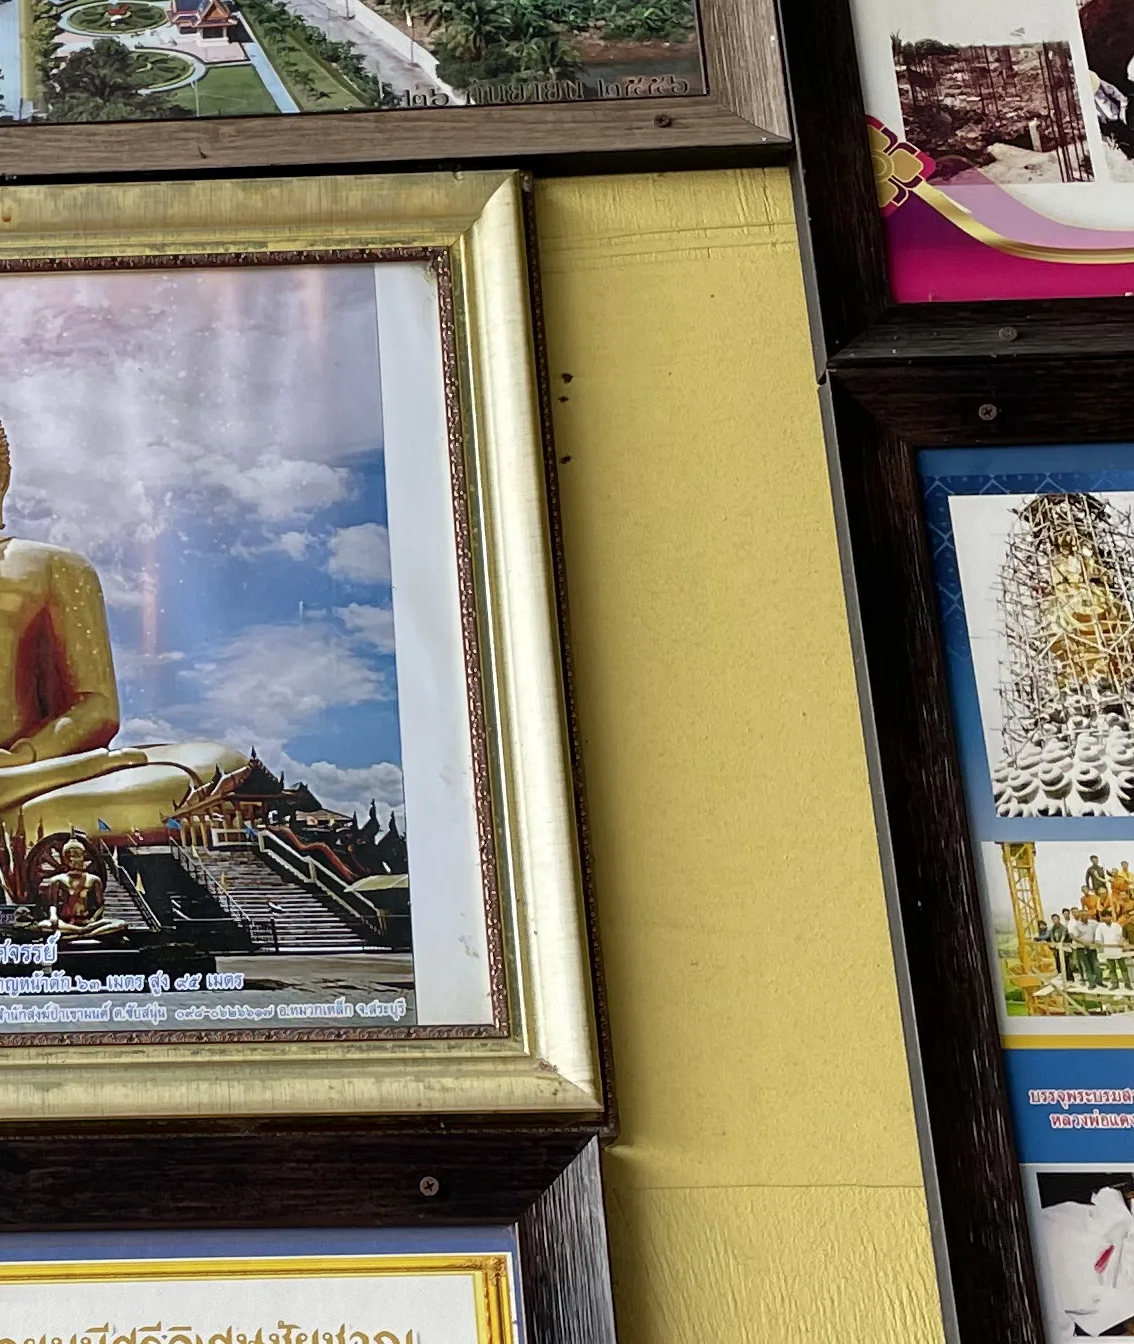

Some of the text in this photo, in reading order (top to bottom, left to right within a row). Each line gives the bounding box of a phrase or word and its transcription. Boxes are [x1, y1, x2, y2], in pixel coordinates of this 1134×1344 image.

[597, 74, 689, 98] ๒๕๕๖
[76, 976, 102, 991] ๖๓
[108, 974, 144, 991] เมตร
[149, 970, 170, 996] สูง
[206, 972, 244, 990] เมตร
